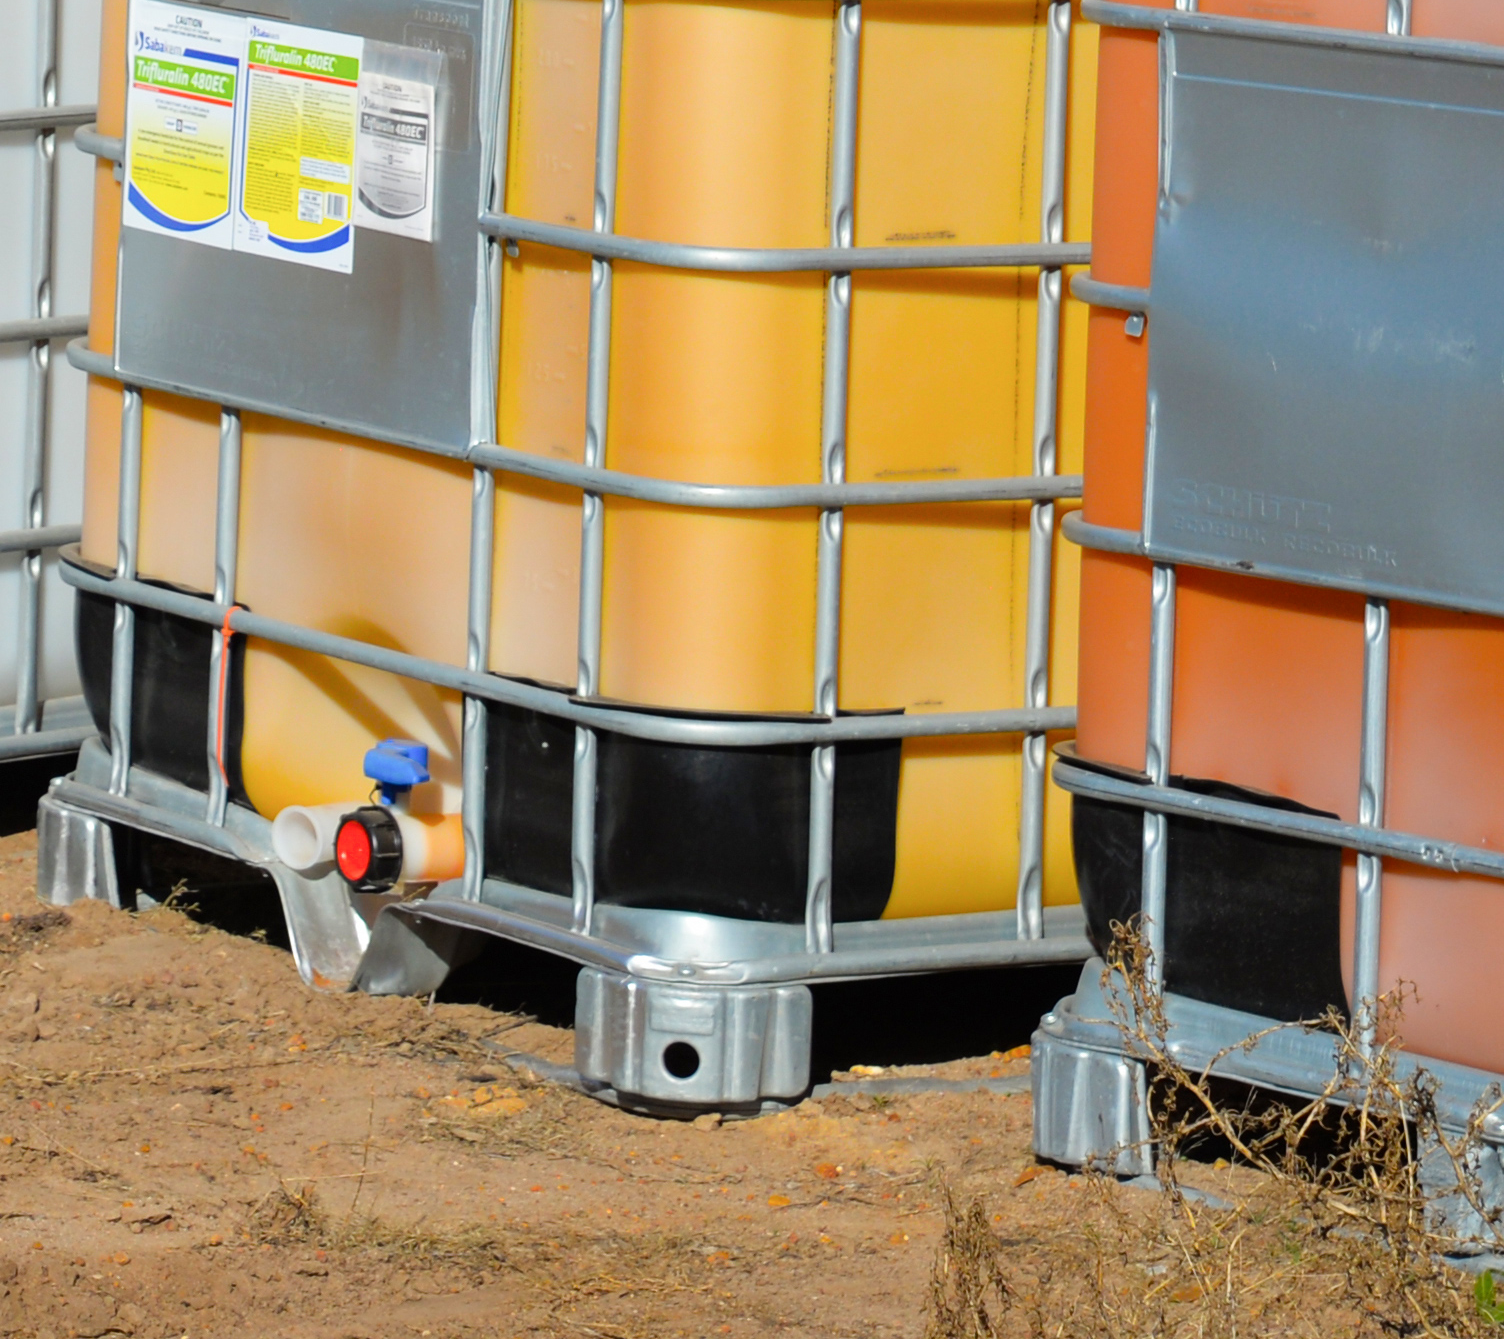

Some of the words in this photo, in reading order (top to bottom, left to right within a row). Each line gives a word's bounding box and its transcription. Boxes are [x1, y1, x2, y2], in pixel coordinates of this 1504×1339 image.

[176, 15, 202, 28] CAUTION
[145, 36, 182, 55] Sabakem
[255, 43, 303, 66] Trifluralin
[136, 59, 190, 85] Trifluralin
